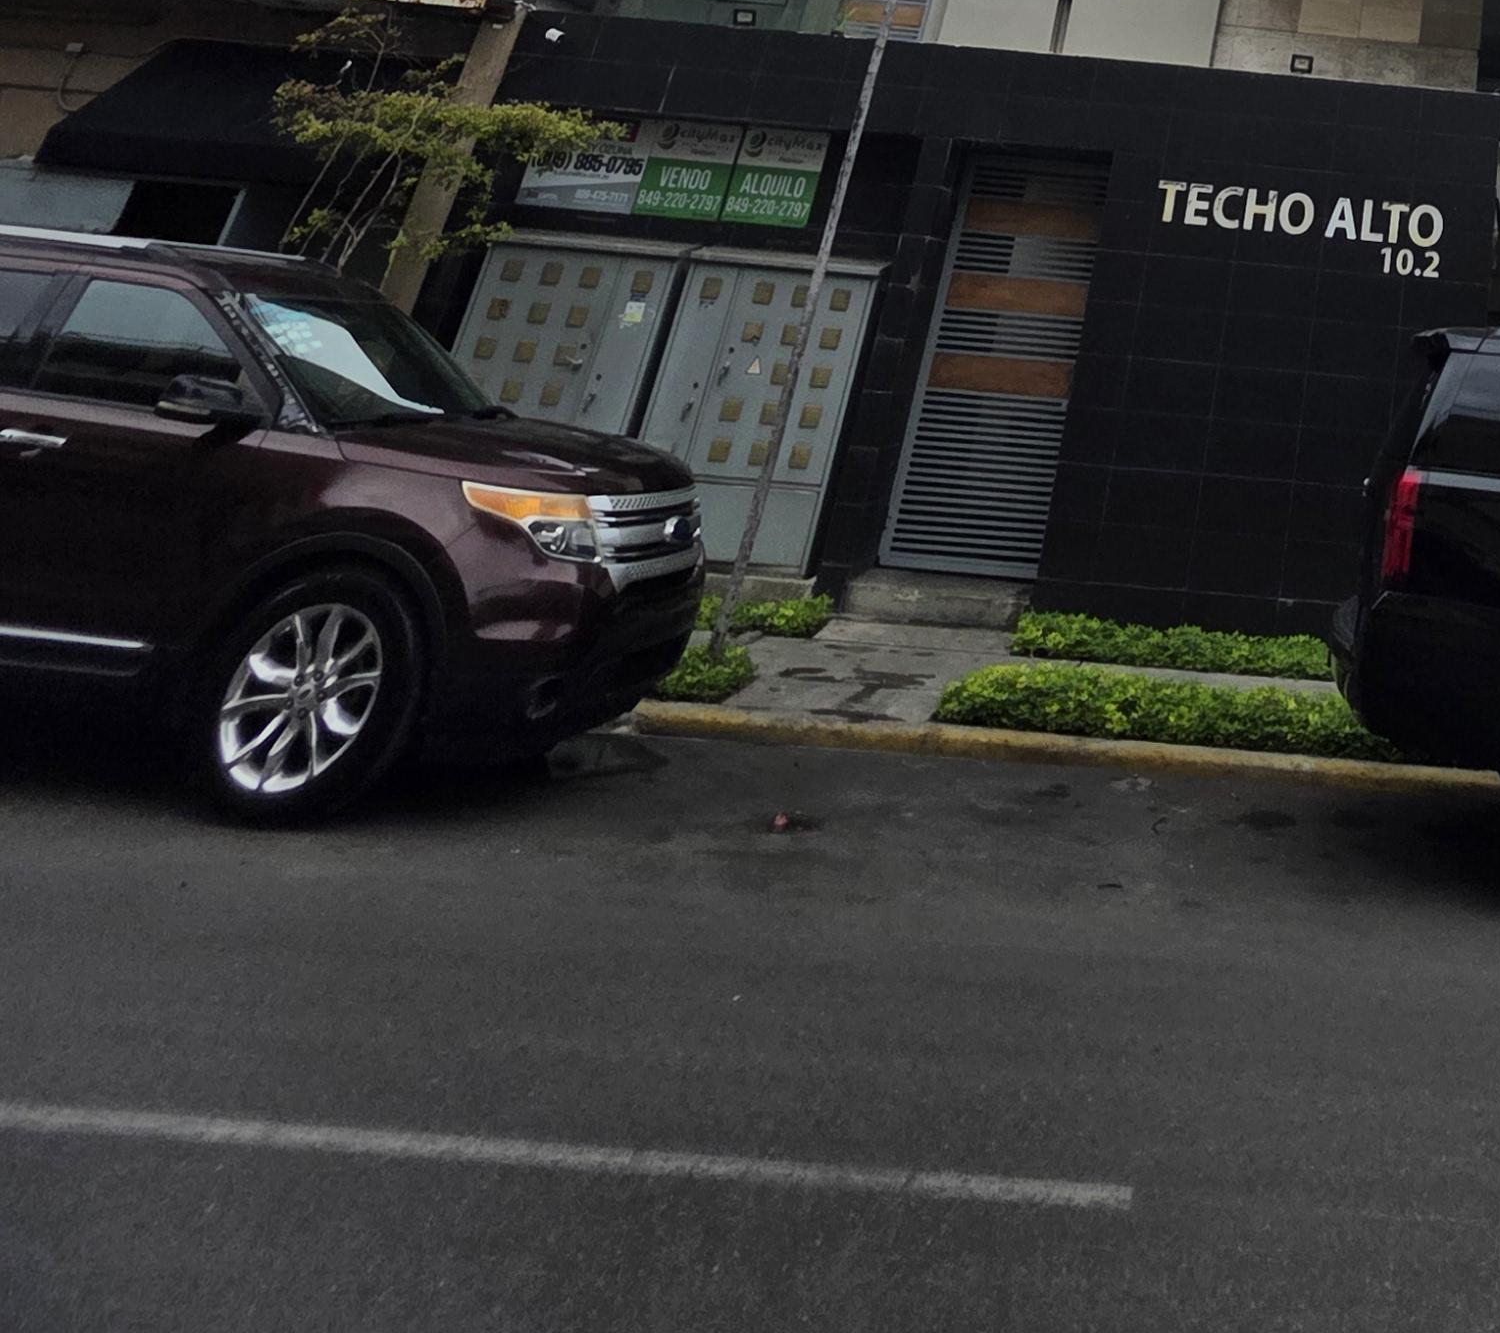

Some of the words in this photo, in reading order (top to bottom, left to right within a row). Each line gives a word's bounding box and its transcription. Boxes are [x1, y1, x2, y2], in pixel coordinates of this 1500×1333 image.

[574, 153, 645, 176] 885-0795
[659, 165, 712, 191] VENDO
[739, 172, 807, 199] ALQUILO
[637, 189, 722, 211] 849-220-2797
[725, 196, 810, 218] 849-220-2797
[1159, 180, 1315, 235] TECHO
[1324, 197, 1444, 247] ALTO
[1380, 247, 1440, 278] 10.2
